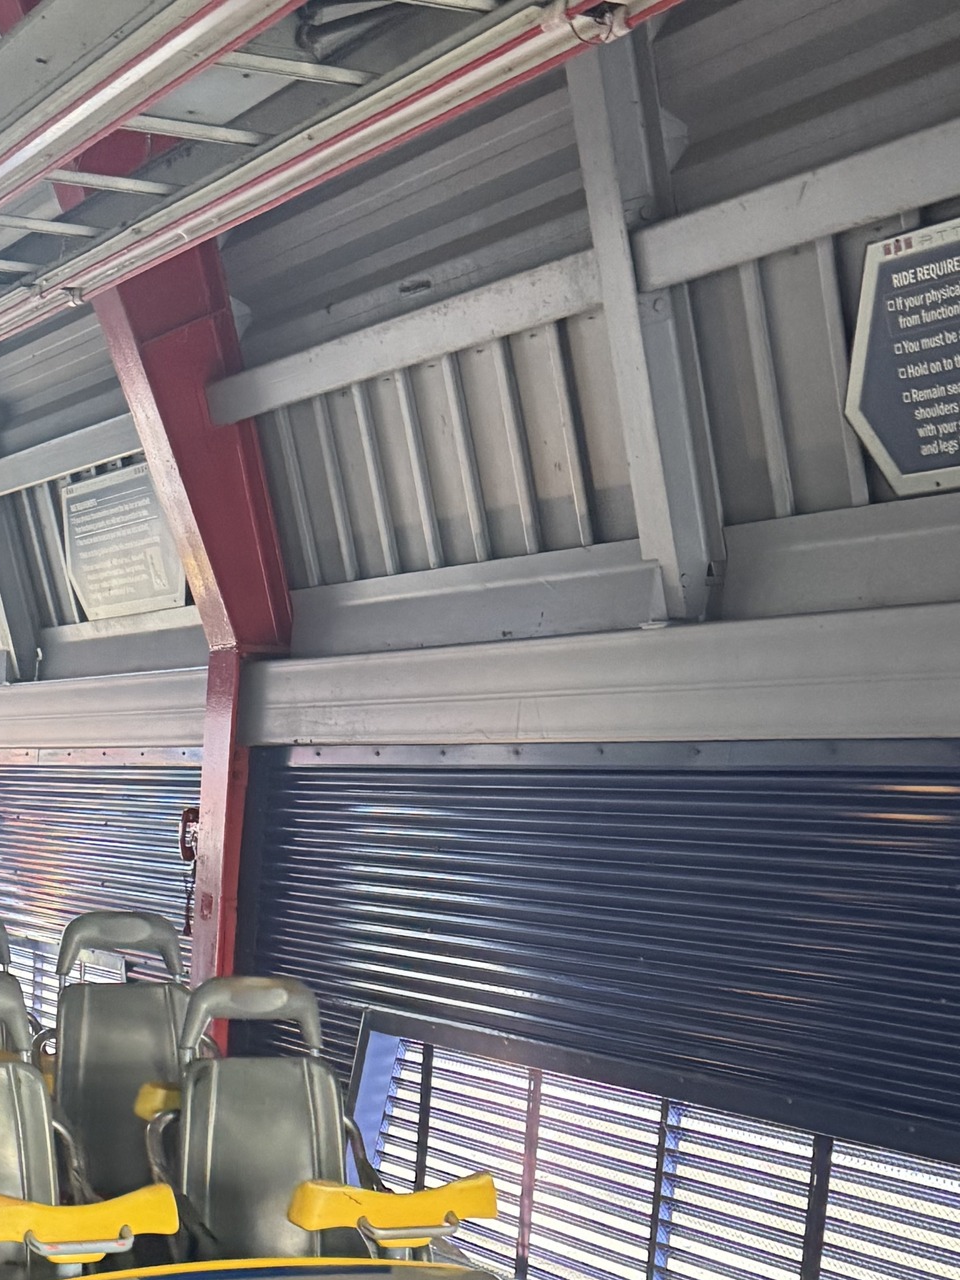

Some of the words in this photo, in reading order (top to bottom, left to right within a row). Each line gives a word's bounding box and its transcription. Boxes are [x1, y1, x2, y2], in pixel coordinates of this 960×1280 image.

[892, 269, 916, 288] RIDE
[895, 297, 904, 311] If
[903, 294, 924, 312] your
[925, 282, 960, 306] physica
[898, 313, 921, 329] from
[902, 340, 920, 354] You
[920, 333, 945, 350] must
[944, 330, 958, 344] be
[907, 361, 929, 378] Hold
[929, 361, 943, 374] on
[942, 357, 954, 371] to
[912, 384, 947, 402] Remain
[914, 402, 960, 420] shoulders
[916, 422, 937, 438] with
[936, 421, 957, 438] your
[920, 439, 939, 456] and
[938, 439, 960, 455] legs
